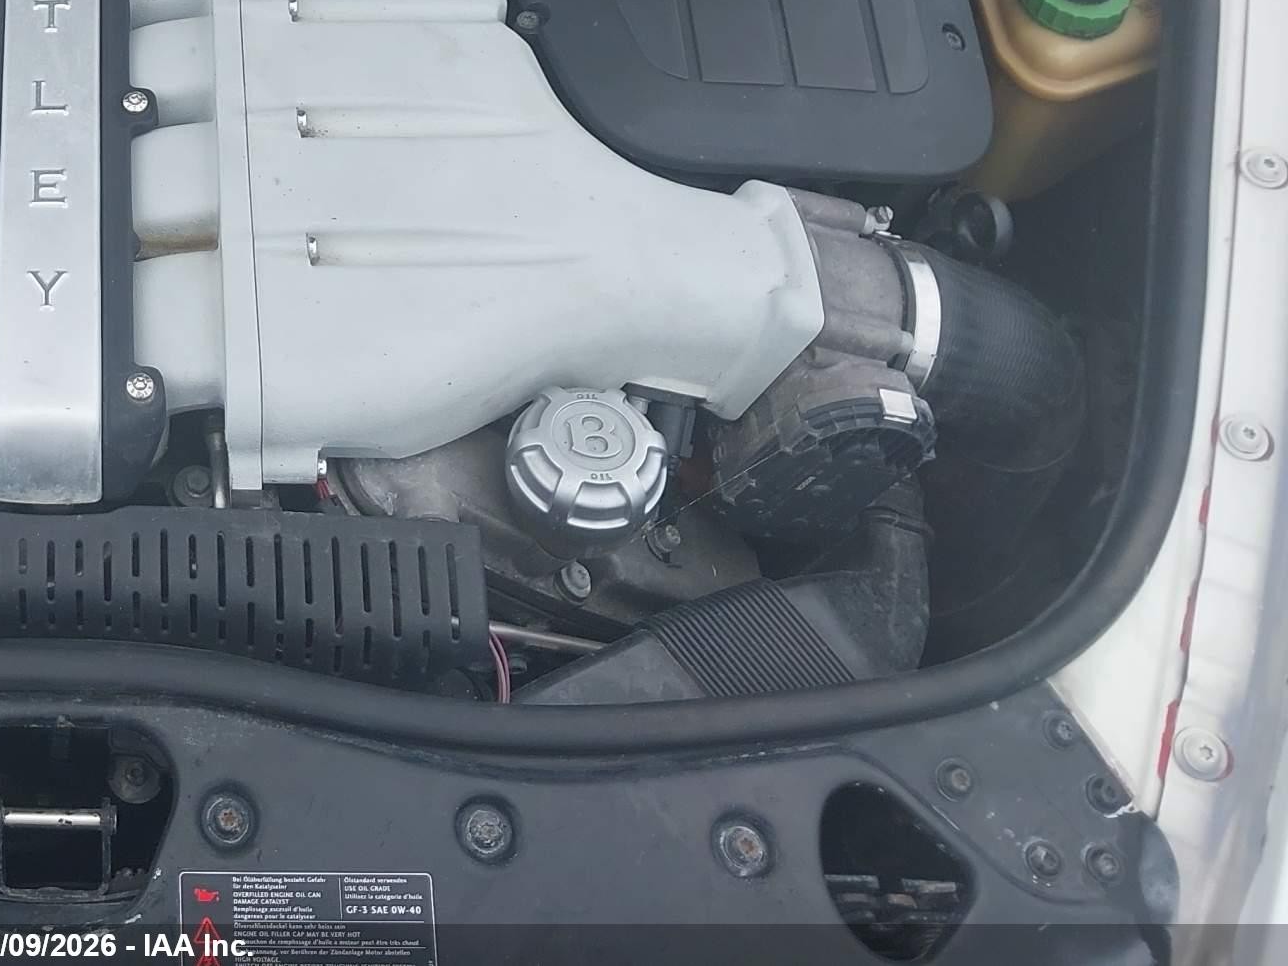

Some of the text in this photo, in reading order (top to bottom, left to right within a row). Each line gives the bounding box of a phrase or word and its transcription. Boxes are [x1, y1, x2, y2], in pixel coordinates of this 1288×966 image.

[591, 472, 612, 481] OIL
[345, 905, 422, 915] GF-3 SAE 0W-40
